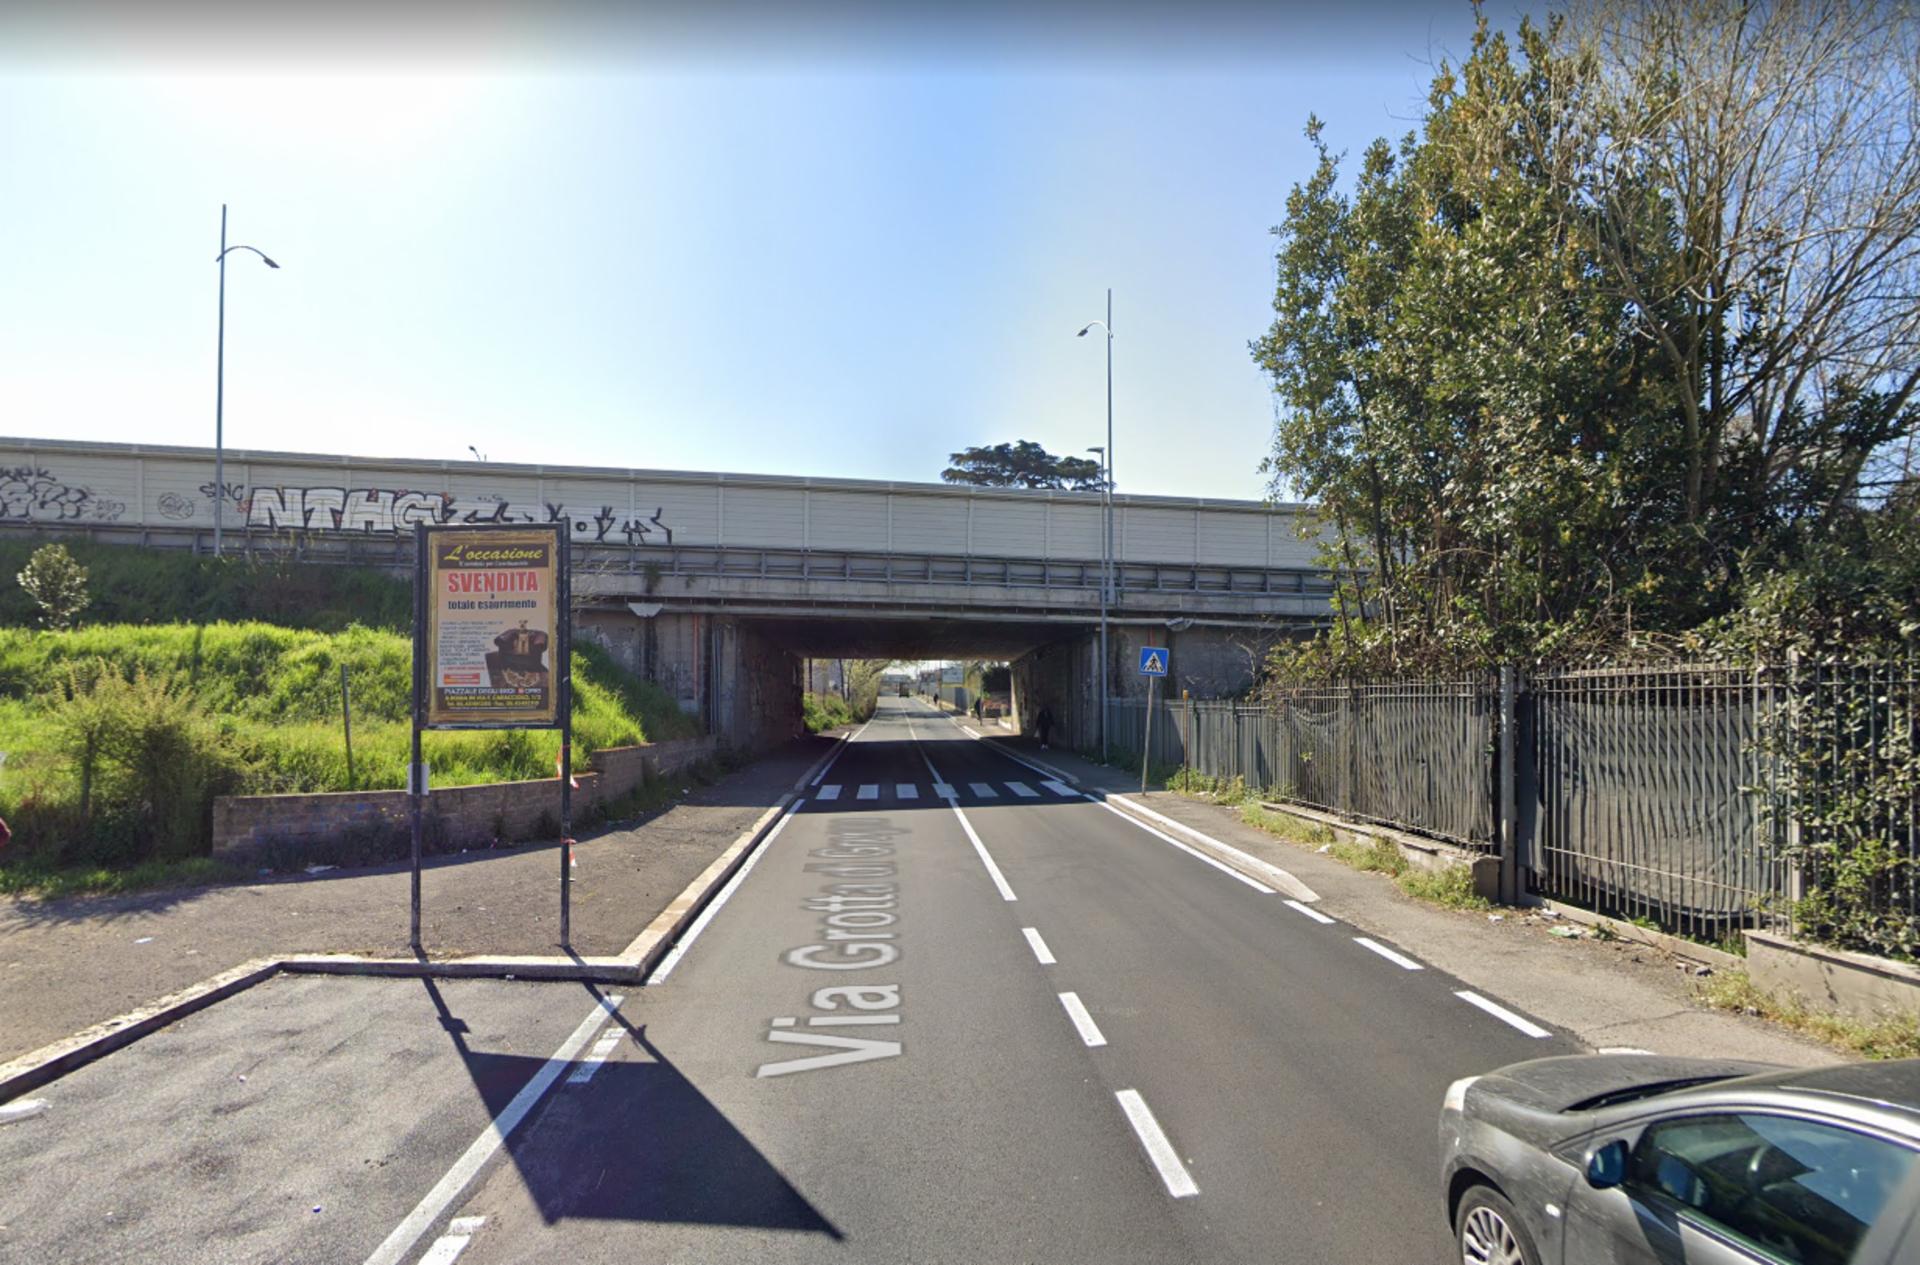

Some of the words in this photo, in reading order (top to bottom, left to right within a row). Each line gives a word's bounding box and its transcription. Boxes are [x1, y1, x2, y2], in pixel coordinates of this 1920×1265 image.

[443, 545, 543, 561] L'occasione
[448, 571, 538, 593] SVENDITA
[448, 600, 476, 610] totale
[477, 599, 537, 610] esaurimento
